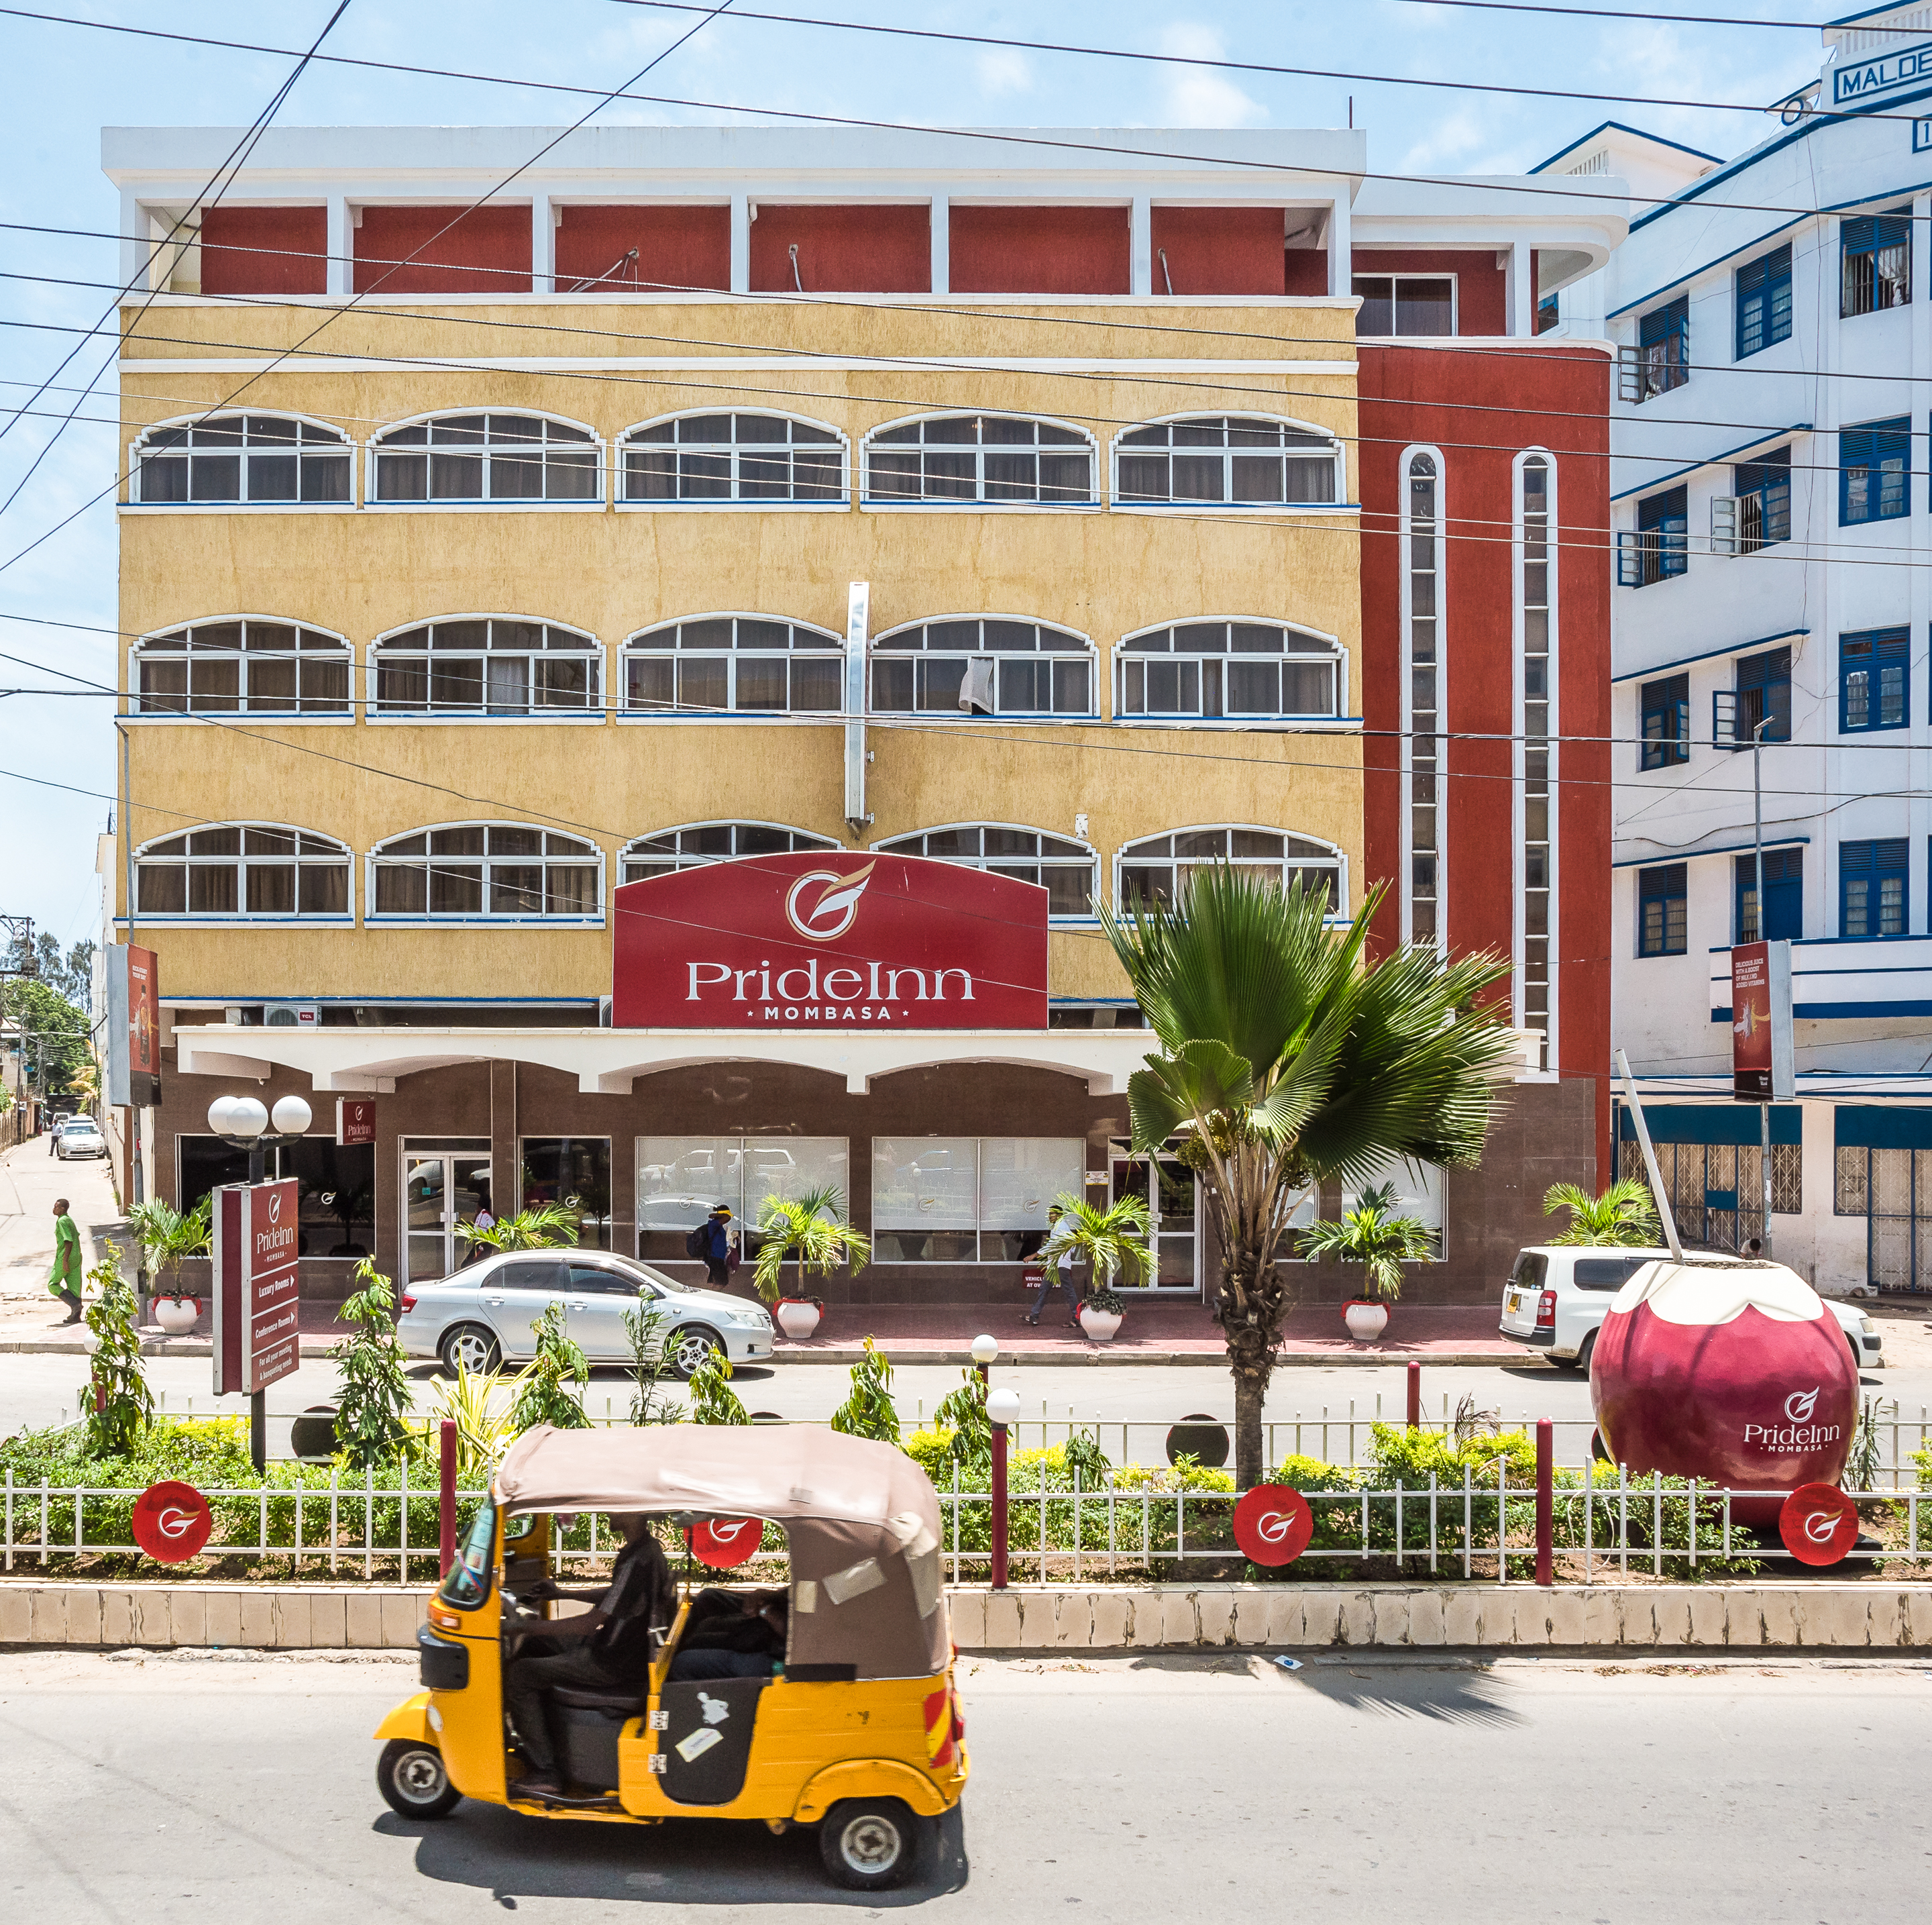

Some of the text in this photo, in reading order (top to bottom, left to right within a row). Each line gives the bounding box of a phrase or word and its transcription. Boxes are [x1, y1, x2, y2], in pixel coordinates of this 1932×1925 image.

[685, 959, 976, 1001] PrideInn
[765, 1006, 891, 1020] MOMBASA
[348, 1123, 371, 1136] PrideInn
[257, 1226, 294, 1254] PrideInn
[259, 1278, 289, 1298] Luxury Rooms
[256, 1316, 290, 1339] Conference Rooms
[270, 1351, 279, 1363] your
[278, 1344, 292, 1357] meeting
[1743, 1424, 1840, 1445] PrideInn
[1768, 1444, 1823, 1453] MOMBASA
